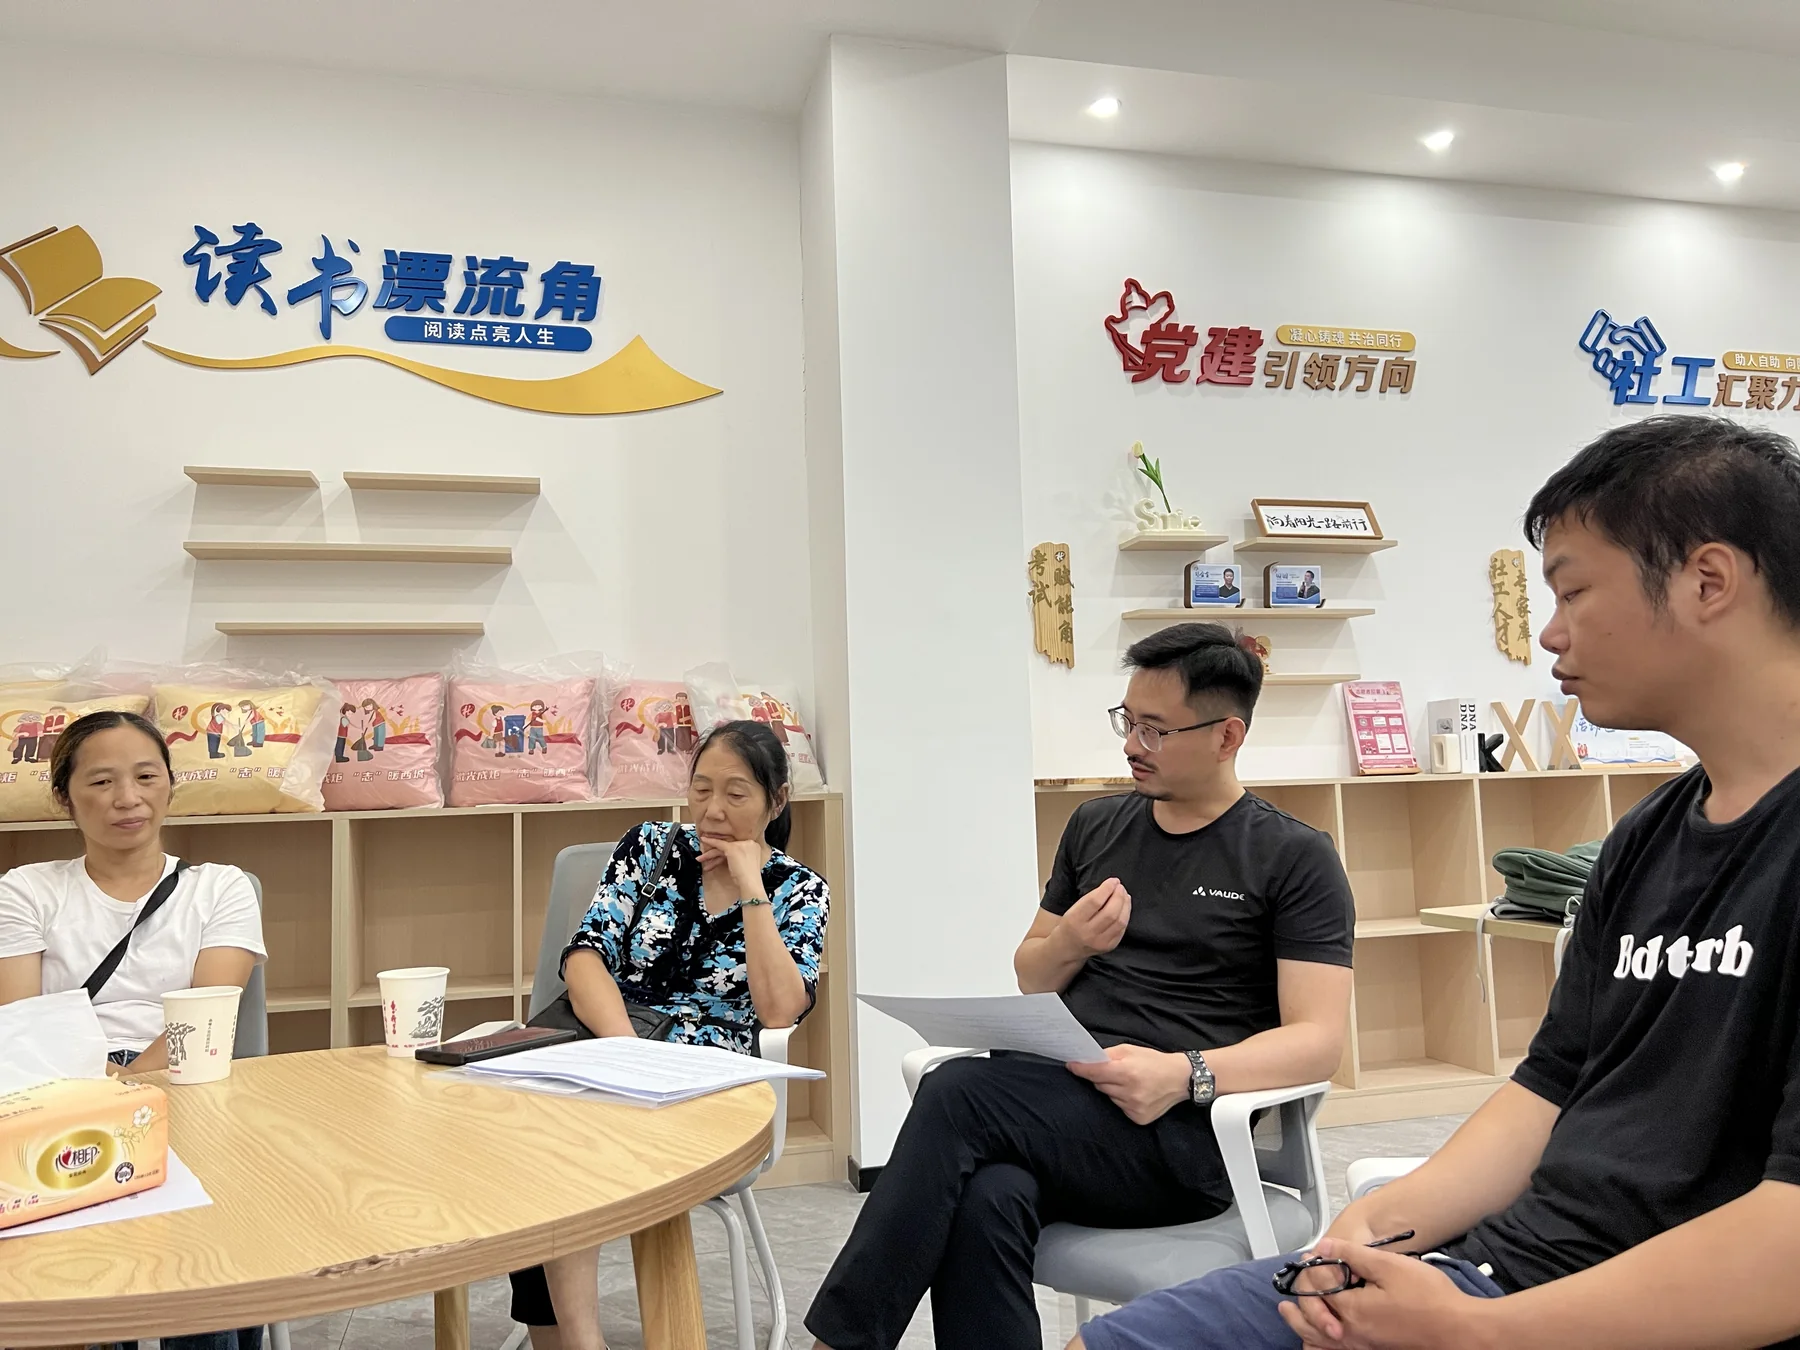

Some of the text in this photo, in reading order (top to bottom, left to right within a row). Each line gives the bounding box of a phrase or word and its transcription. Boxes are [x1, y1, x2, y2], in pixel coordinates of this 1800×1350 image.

[183, 221, 604, 340] 读书漂流角
[423, 320, 555, 346] 阅读点亮人生
[1289, 328, 1402, 348] 凝心铸魂 共治同行
[1131, 323, 1417, 393] 党建 引领方向
[1734, 353, 1781, 369] 助人自助
[1610, 350, 1800, 411] 社工 汇聚力
[1028, 549, 1052, 608] 考试
[1054, 564, 1075, 645] 赋能角
[1489, 557, 1514, 645] 社工人才
[1460, 704, 1468, 731] DNA
[1468, 704, 1476, 731] DNA
[173, 768, 218, 783] 光成炬
[55, 1146, 100, 1173] 心相印
